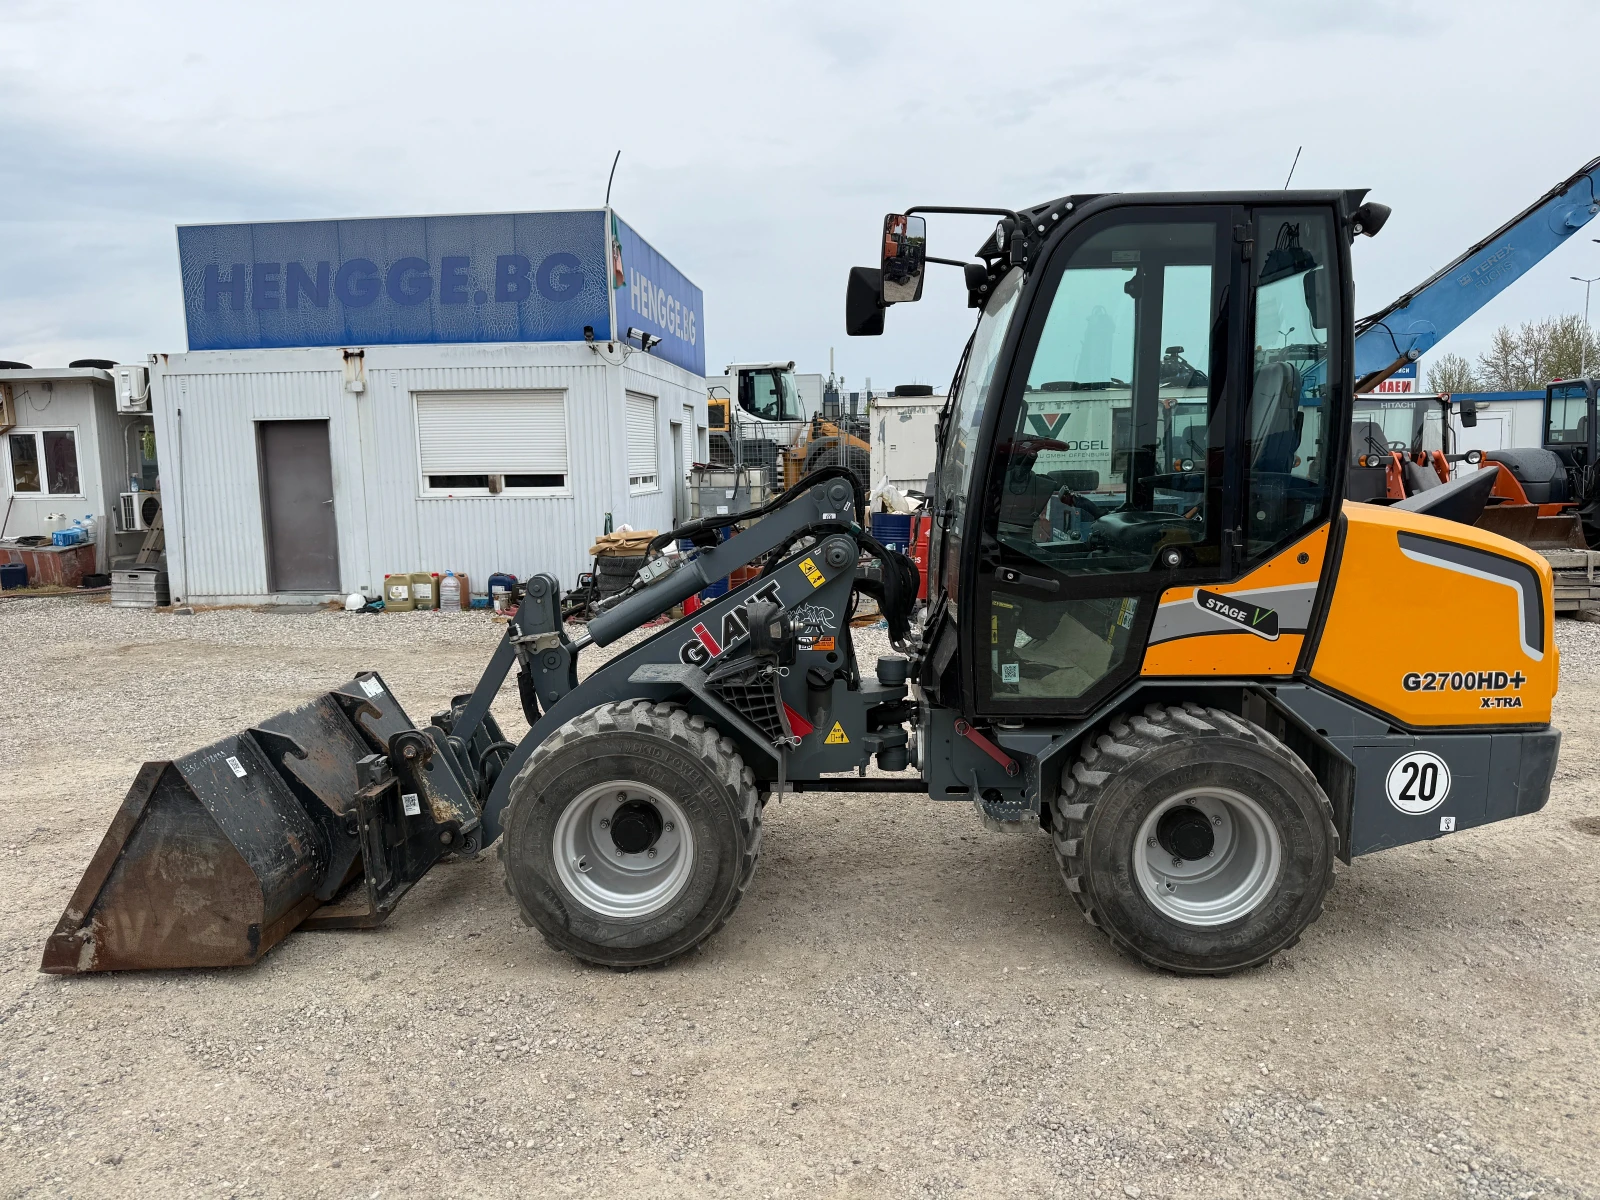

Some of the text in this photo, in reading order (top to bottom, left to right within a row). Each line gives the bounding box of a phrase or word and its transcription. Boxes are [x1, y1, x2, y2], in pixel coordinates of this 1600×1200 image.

[1471, 242, 1515, 276] TEREX
[203, 252, 586, 312] HENGGE.BG
[1474, 261, 1513, 290] FUCHS
[630, 266, 697, 346] HENGGE.BG
[1380, 402, 1416, 410] HITACHI
[1066, 440, 1109, 451] OGEL
[1206, 598, 1248, 622] STAGE
[1402, 670, 1526, 692] G2700HD+
[1479, 696, 1524, 709] X-TRA
[1398, 761, 1439, 802] 20
